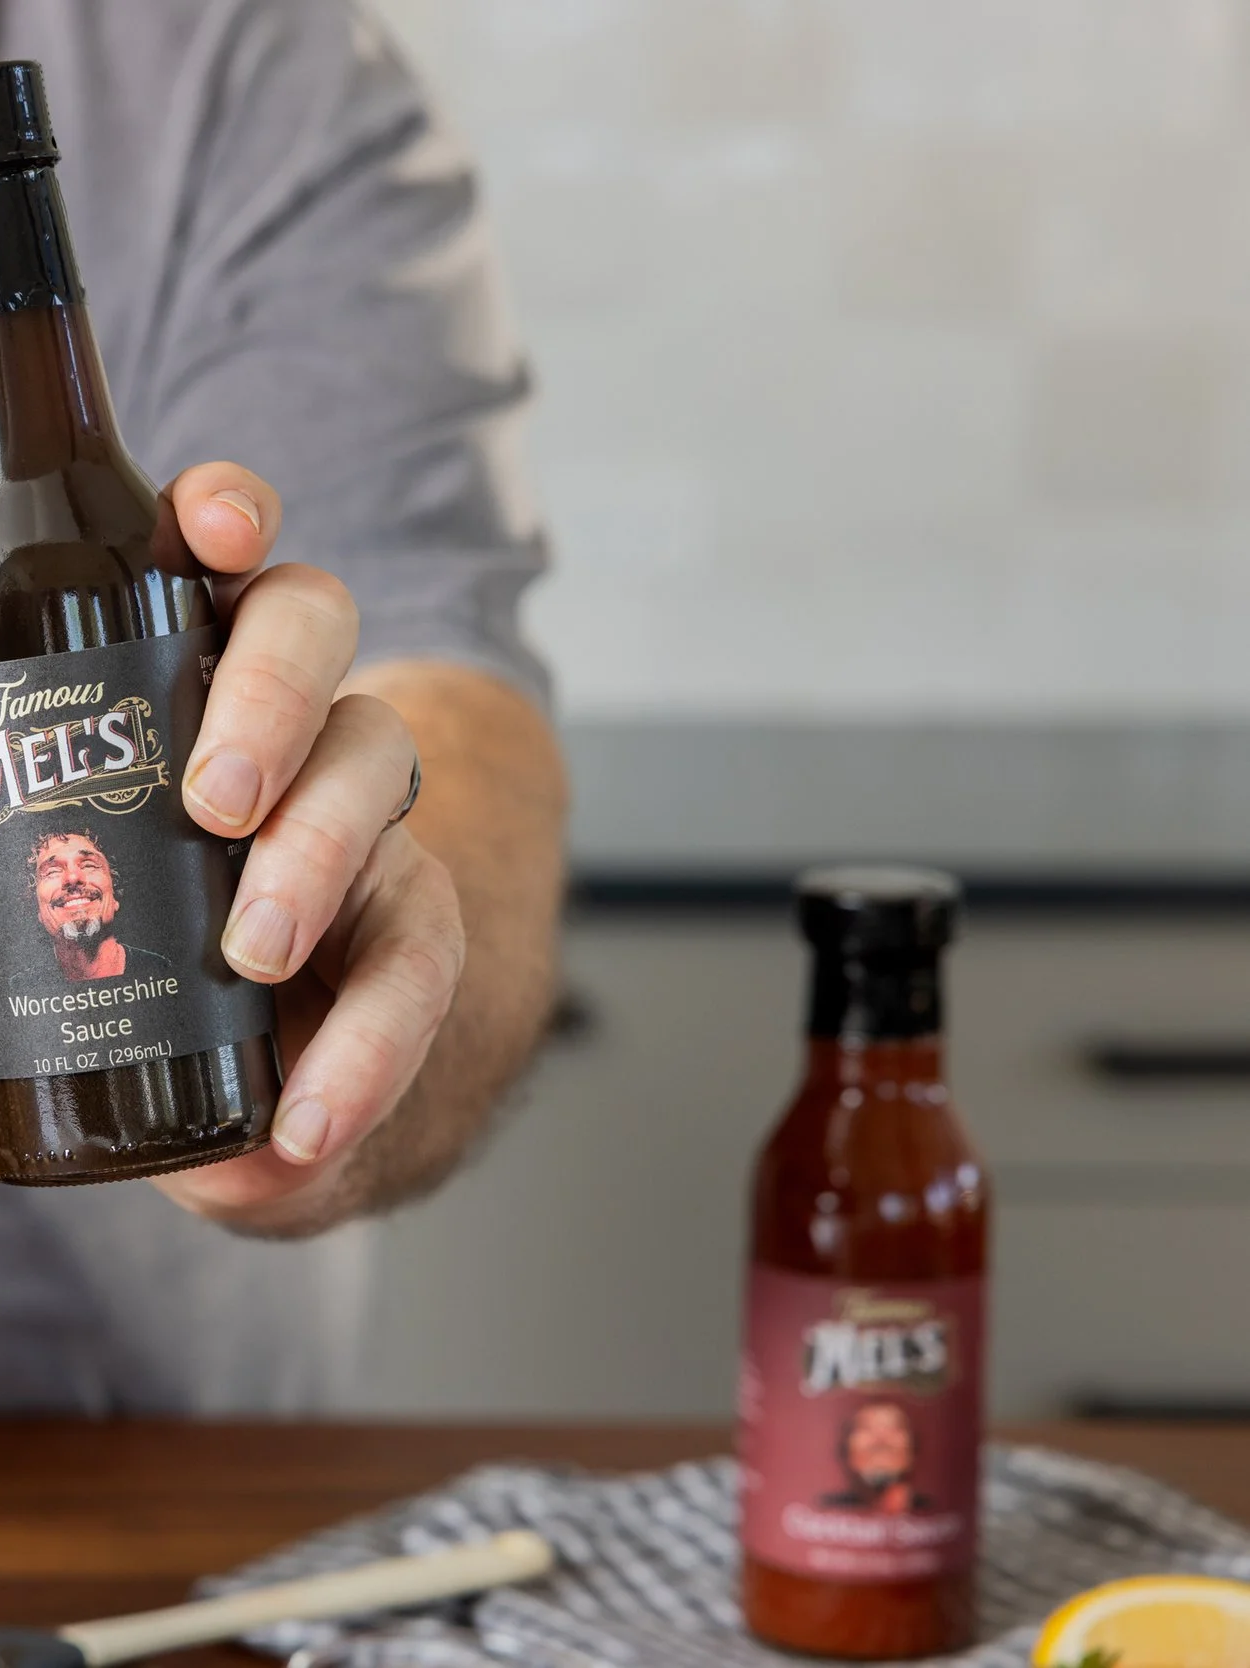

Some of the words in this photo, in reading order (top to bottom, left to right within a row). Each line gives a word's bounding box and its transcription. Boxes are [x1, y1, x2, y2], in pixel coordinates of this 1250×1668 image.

[8, 976, 179, 1017] Worcestershire
[60, 1017, 133, 1044] Sauce
[33, 1058, 51, 1075] 10
[55, 1056, 73, 1072] FL
[76, 1052, 100, 1069] OZ
[108, 1039, 173, 1067] (296mL)
